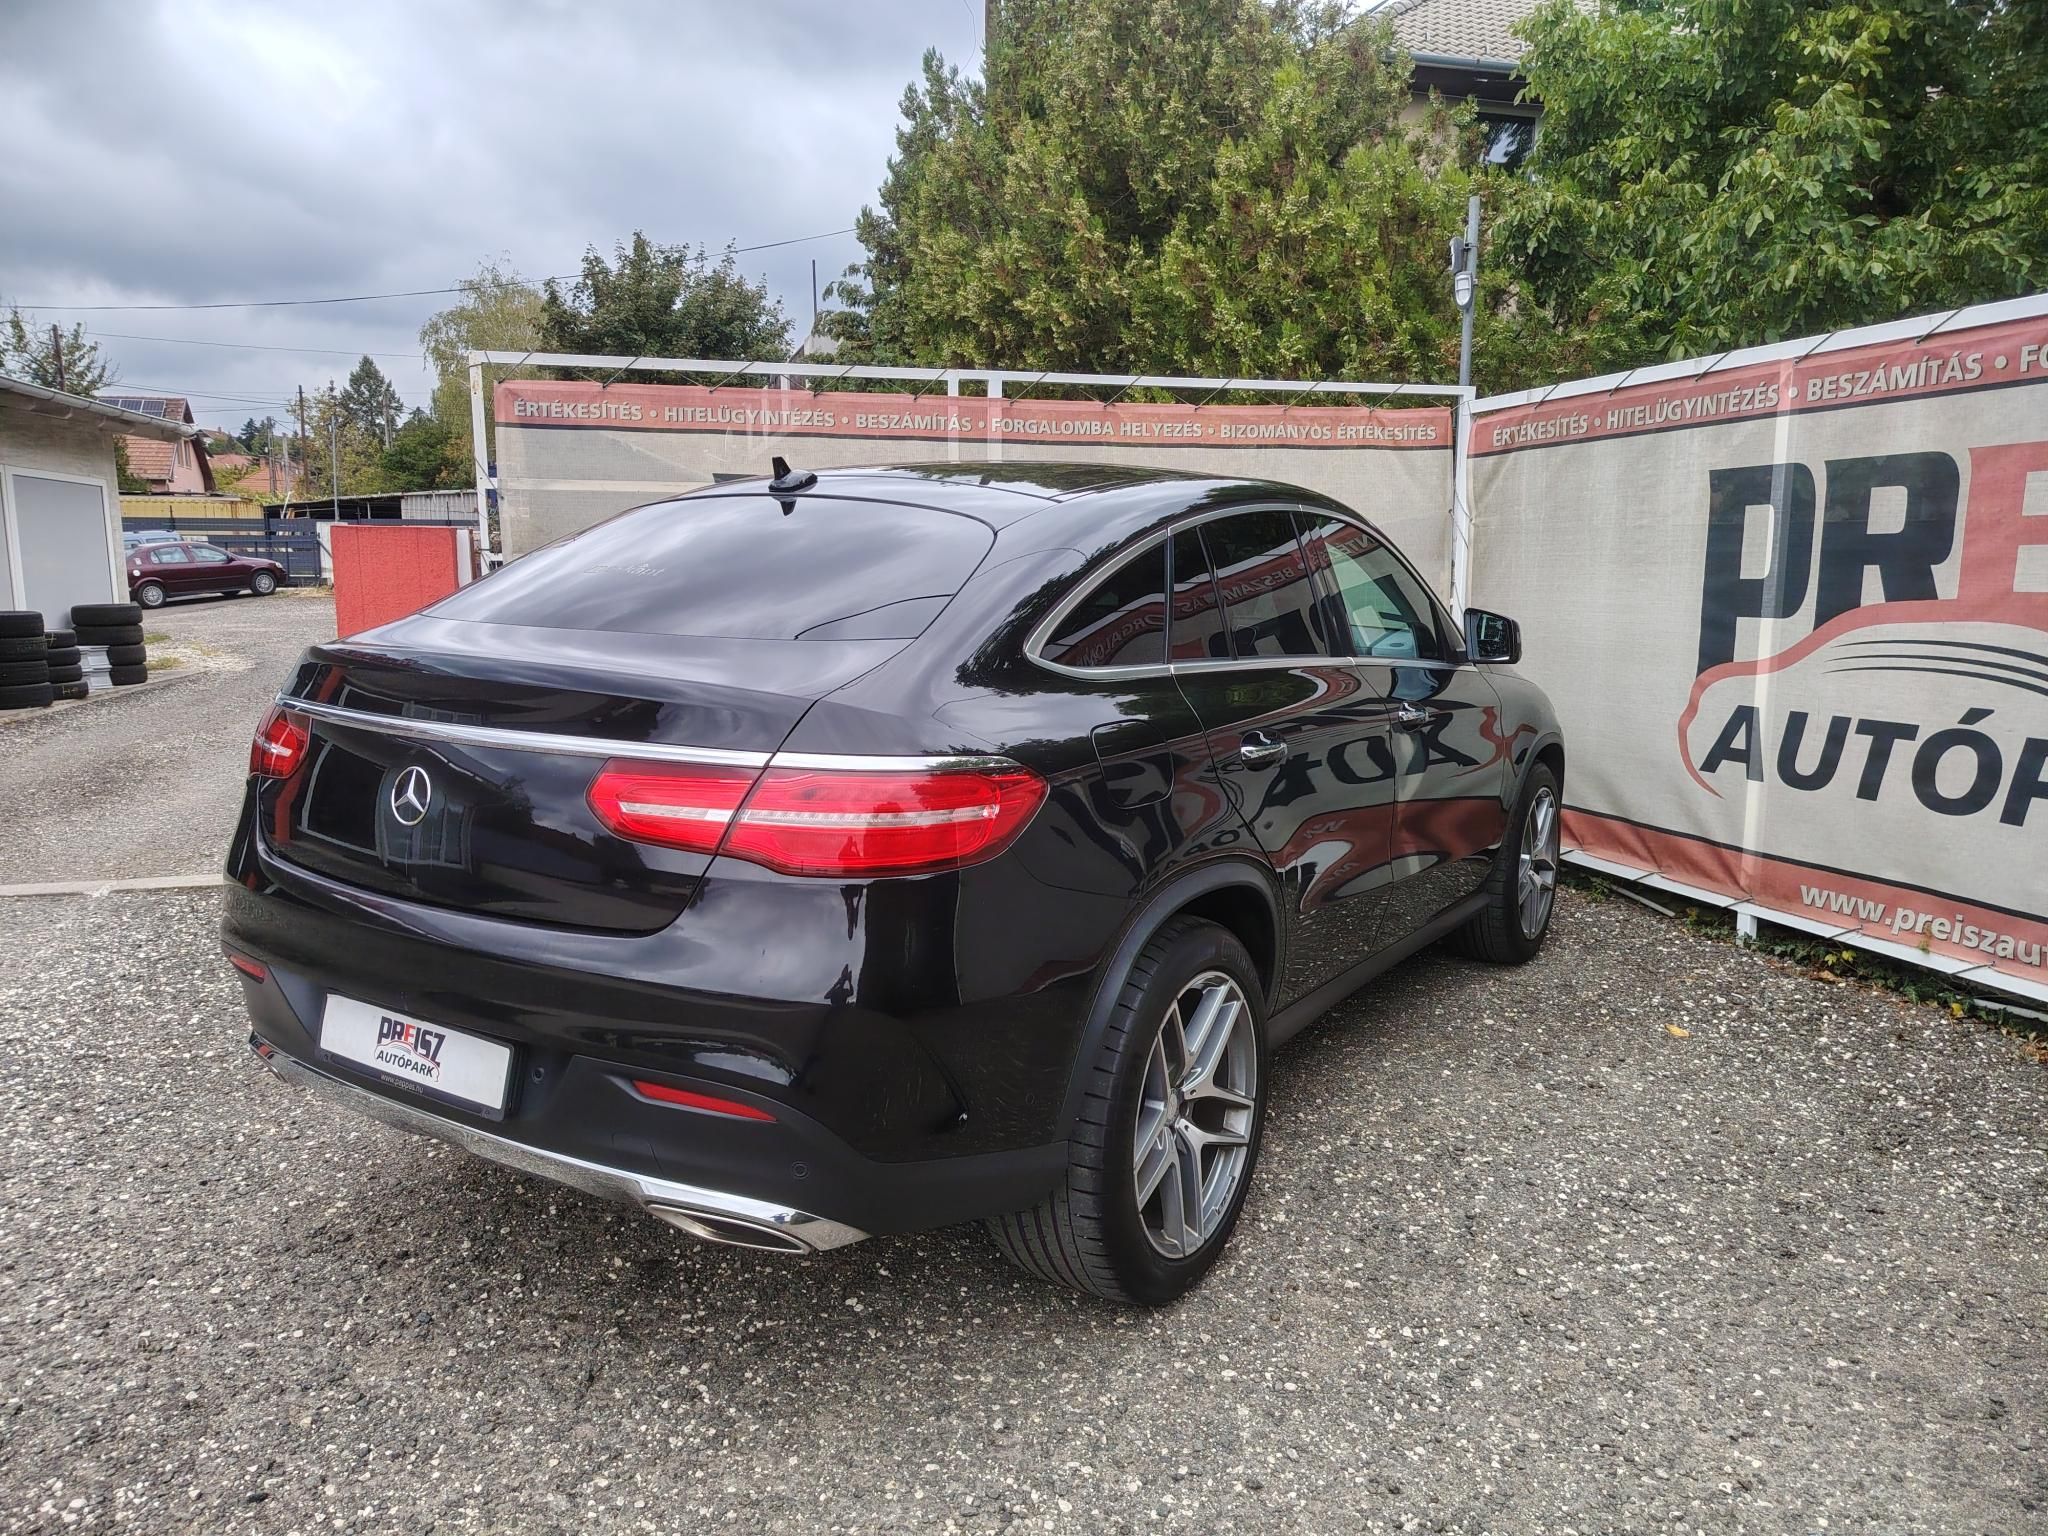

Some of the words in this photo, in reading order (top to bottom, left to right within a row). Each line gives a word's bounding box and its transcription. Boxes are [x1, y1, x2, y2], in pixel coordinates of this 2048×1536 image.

[513, 400, 642, 421] ÉRTÉKESÍTÉS
[664, 405, 835, 429] HITELÜGYINTÉZÉS
[855, 410, 972, 433] BESZÁMÍTÁS
[991, 417, 1115, 437] FORGALOMBA
[1120, 419, 1203, 439] HELYEZÉS
[1220, 421, 1332, 441] BIZOMÁNYOS
[1337, 423, 1437, 442] ÉRTÉKESÍTÉS
[1492, 413, 1588, 448] ÉRTÉKESÍTÉS
[1606, 381, 1780, 431] HITELÜGYINTÉZÉS
[1806, 351, 1984, 401] BESZÁMÍTÁS
[376, 1049, 434, 1078] AUTÓPARK
[377, 1015, 447, 1068] PREISZ
